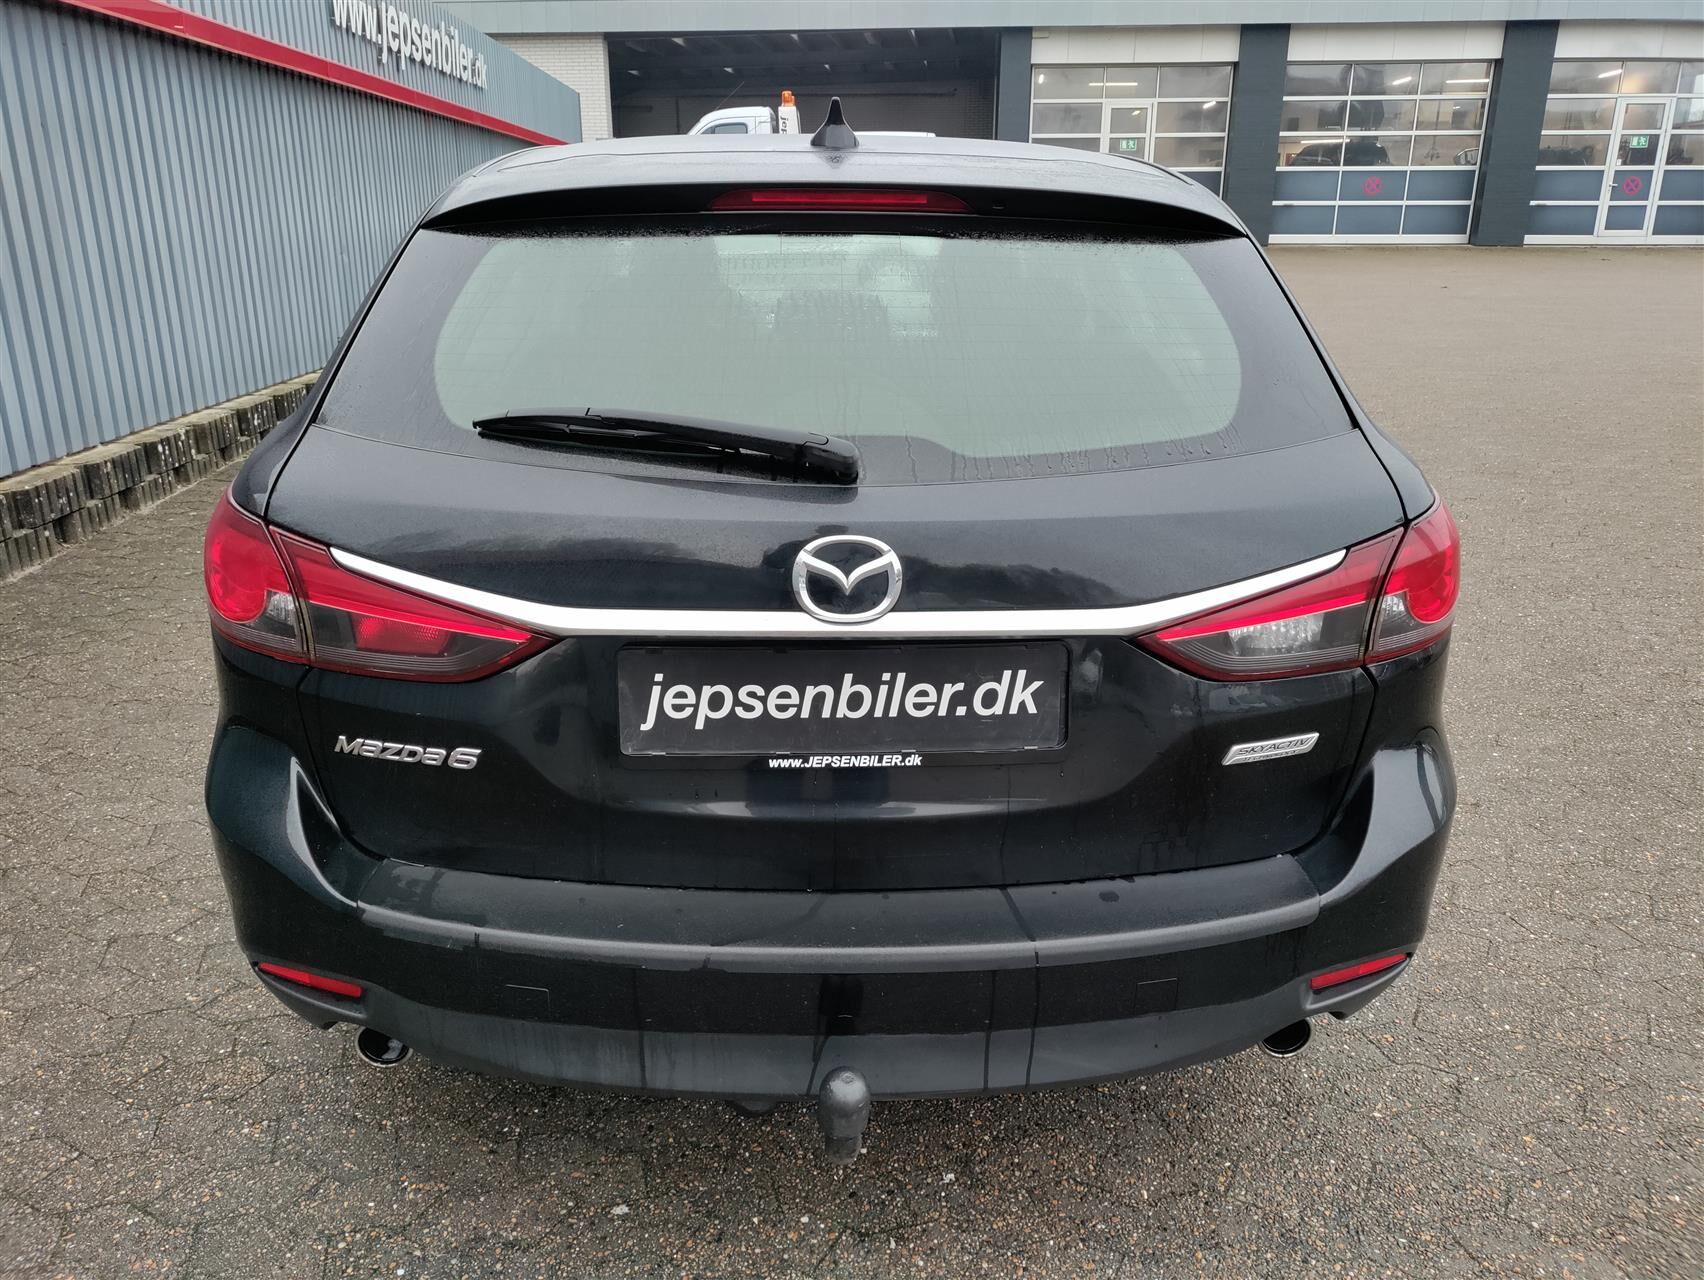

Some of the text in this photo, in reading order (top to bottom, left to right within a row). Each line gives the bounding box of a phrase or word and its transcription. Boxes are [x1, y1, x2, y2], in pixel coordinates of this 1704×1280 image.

[332, 0, 487, 88] www.jepsenbiler.dk
[640, 669, 1045, 731] jepsenbiler.dk
[768, 754, 922, 768] www.JEPSENBILER.dk
[1239, 737, 1311, 755] SKYACTIV
